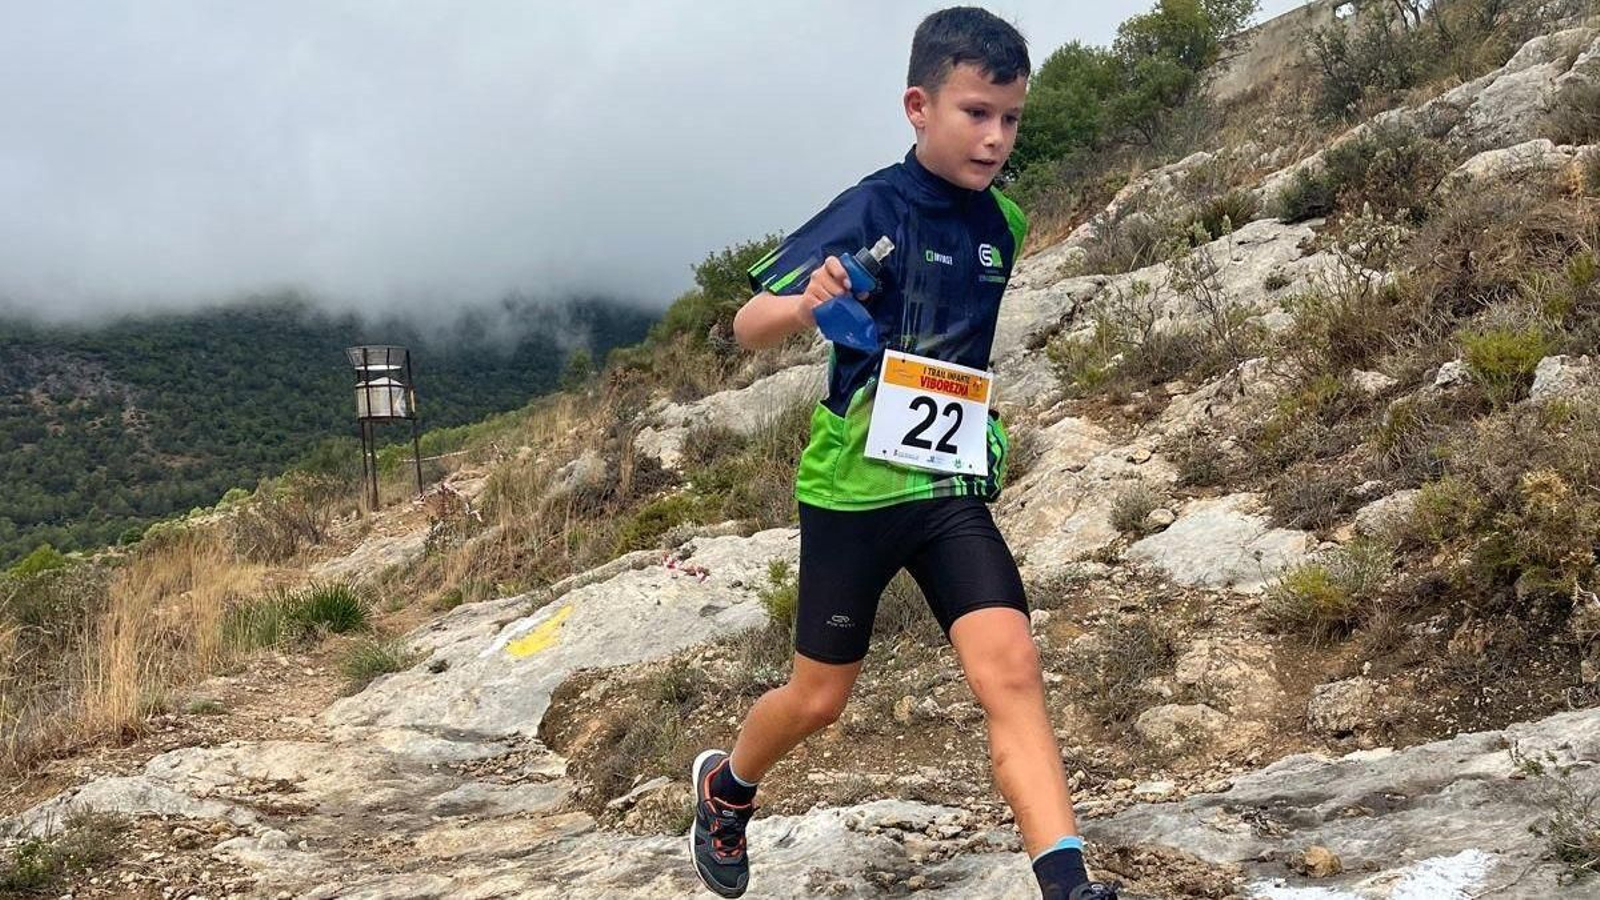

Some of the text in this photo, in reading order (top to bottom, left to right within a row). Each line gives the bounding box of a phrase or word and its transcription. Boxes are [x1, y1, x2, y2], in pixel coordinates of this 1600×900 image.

[928, 367, 946, 379] TRAIL
[920, 375, 969, 397] VIBOREZNA
[901, 395, 964, 455] 22
